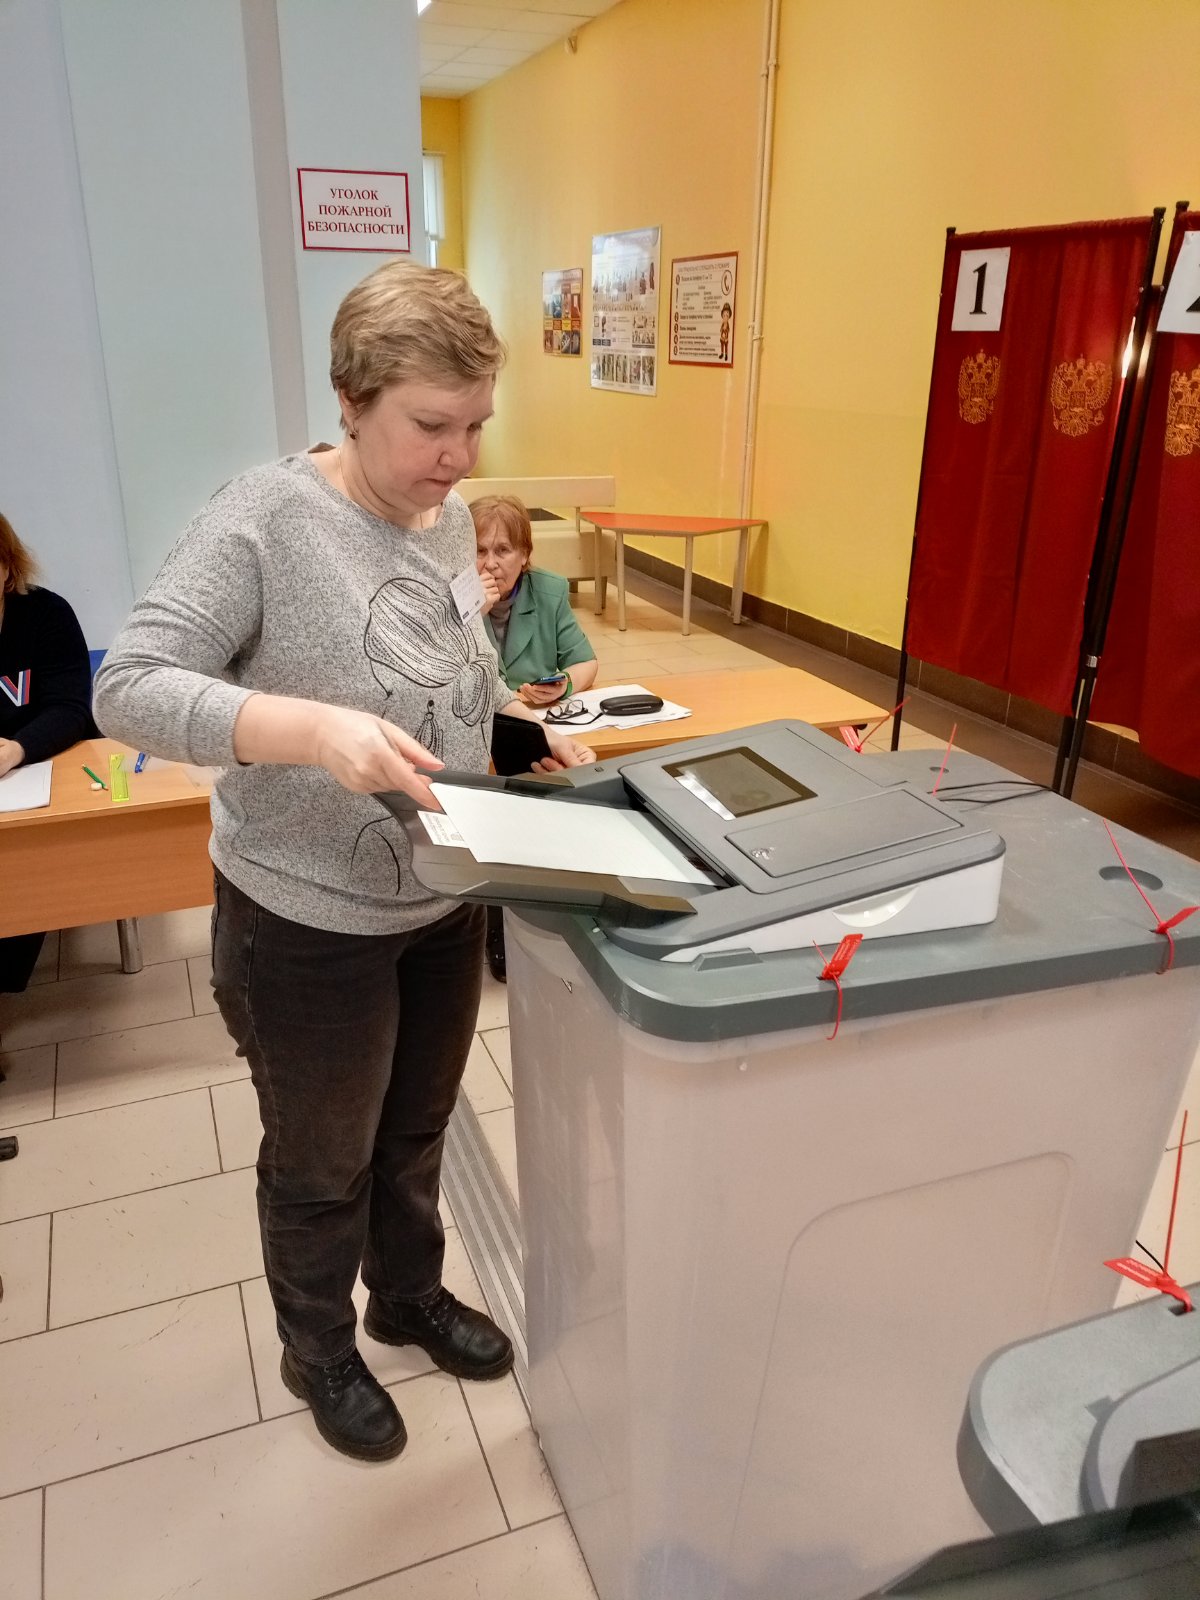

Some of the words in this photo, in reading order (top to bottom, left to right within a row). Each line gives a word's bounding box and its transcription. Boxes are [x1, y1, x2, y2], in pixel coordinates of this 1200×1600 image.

[329, 187, 379, 201] УГОЛОК
[318, 204, 392, 218] ПОЖАРНОЙ
[307, 220, 405, 235] БЕЗОПАСНОСТИ
[969, 261, 988, 315] 1
